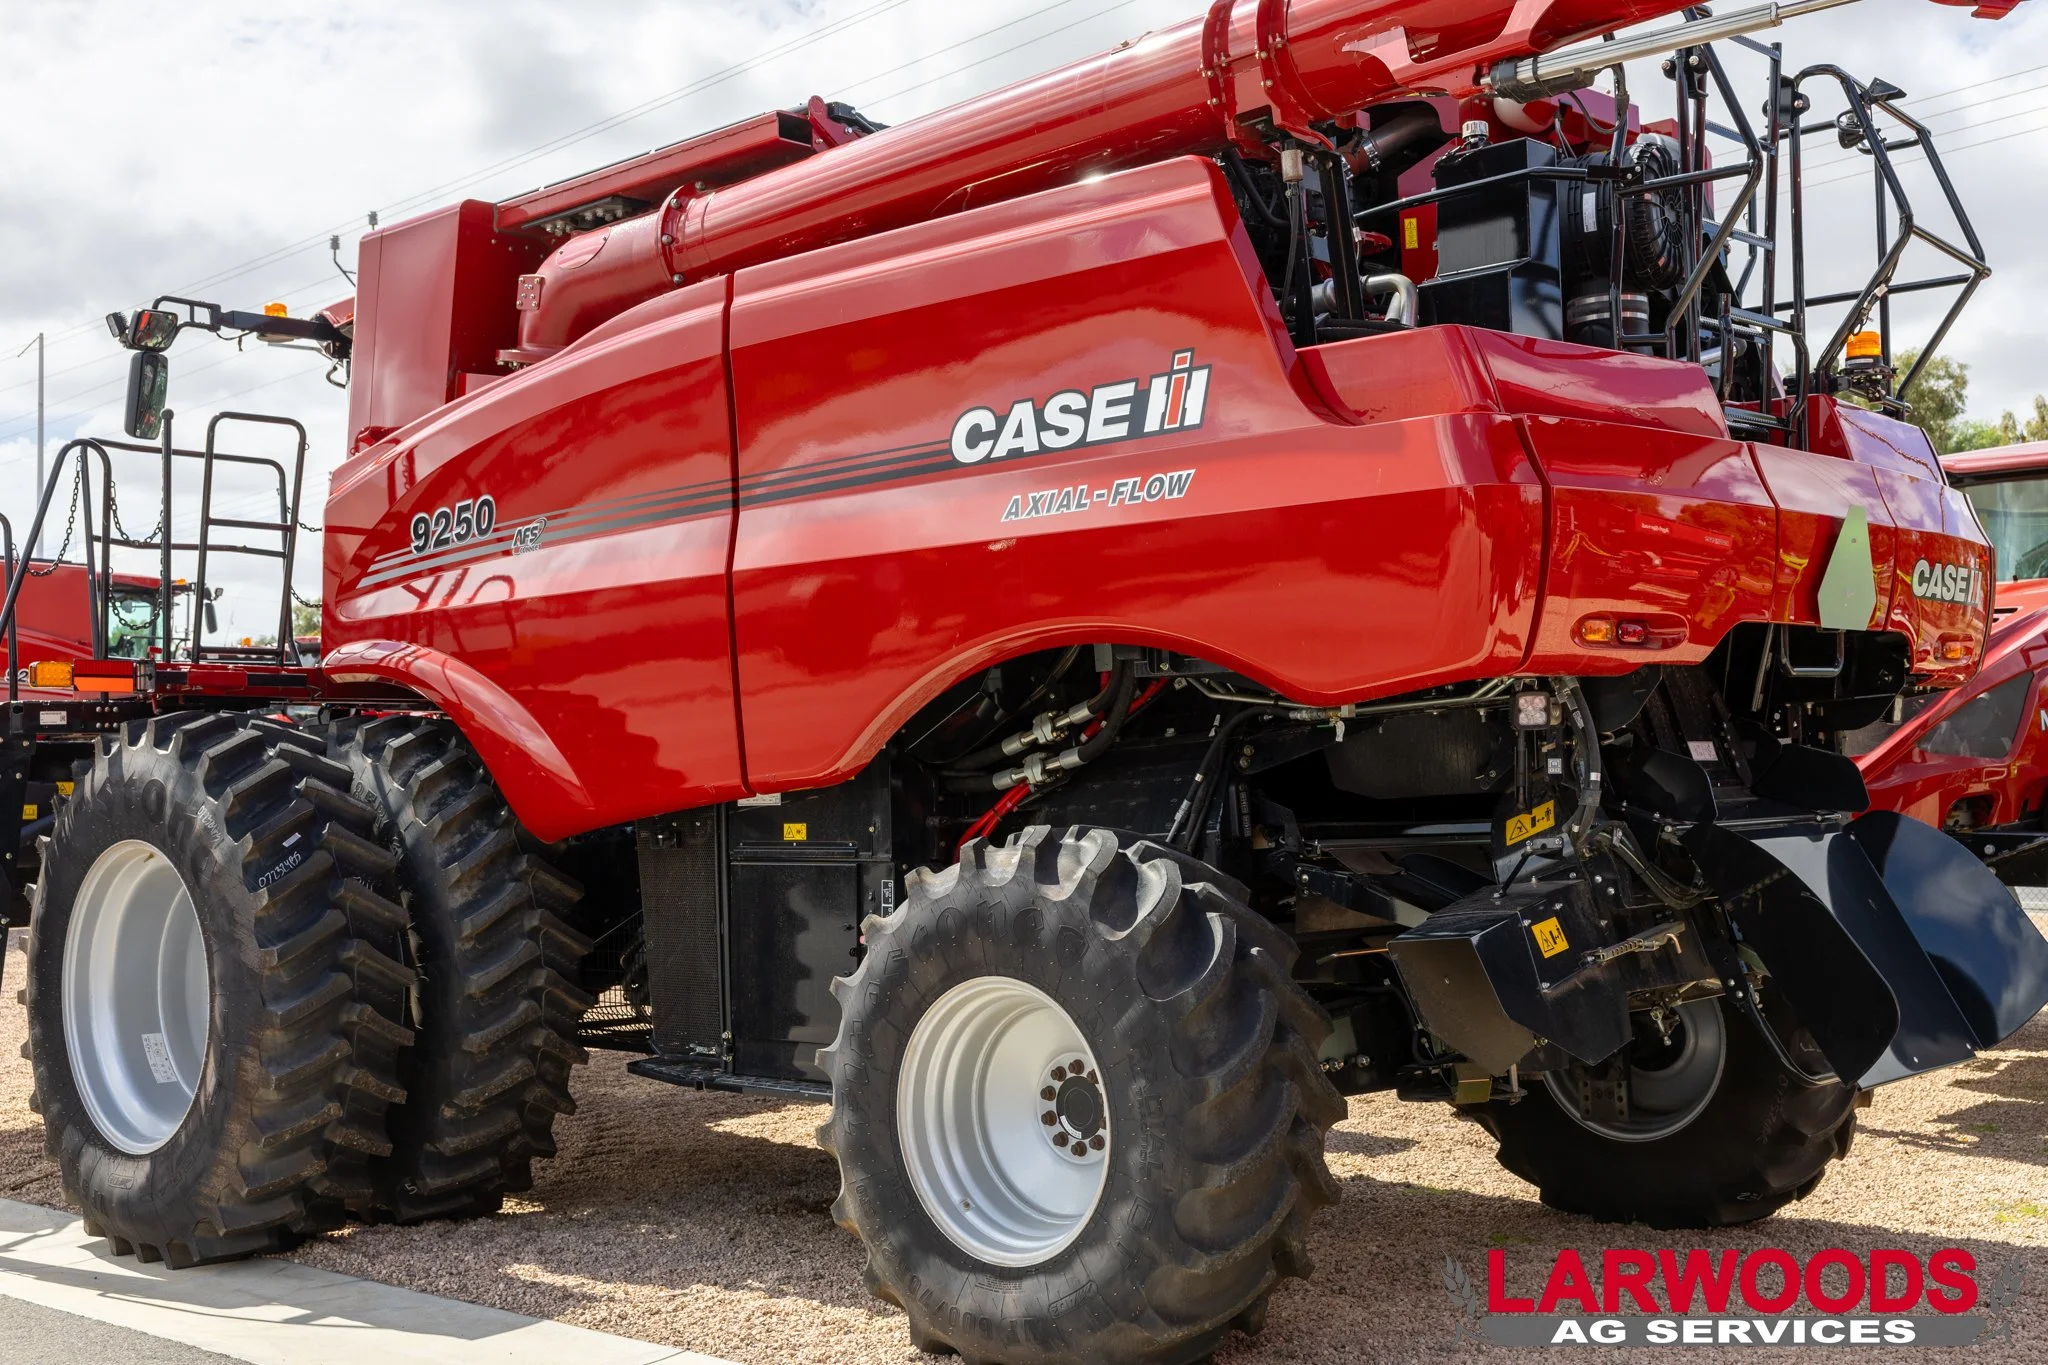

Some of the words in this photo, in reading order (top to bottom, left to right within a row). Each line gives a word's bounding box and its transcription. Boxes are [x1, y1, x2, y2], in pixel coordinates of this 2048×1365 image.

[951, 381, 1137, 464] CASE
[1000, 469, 1196, 522] AXIAL-FLOW
[411, 494, 496, 554] 9250
[512, 525, 540, 547] AFS
[1912, 558, 1968, 602] CASE
